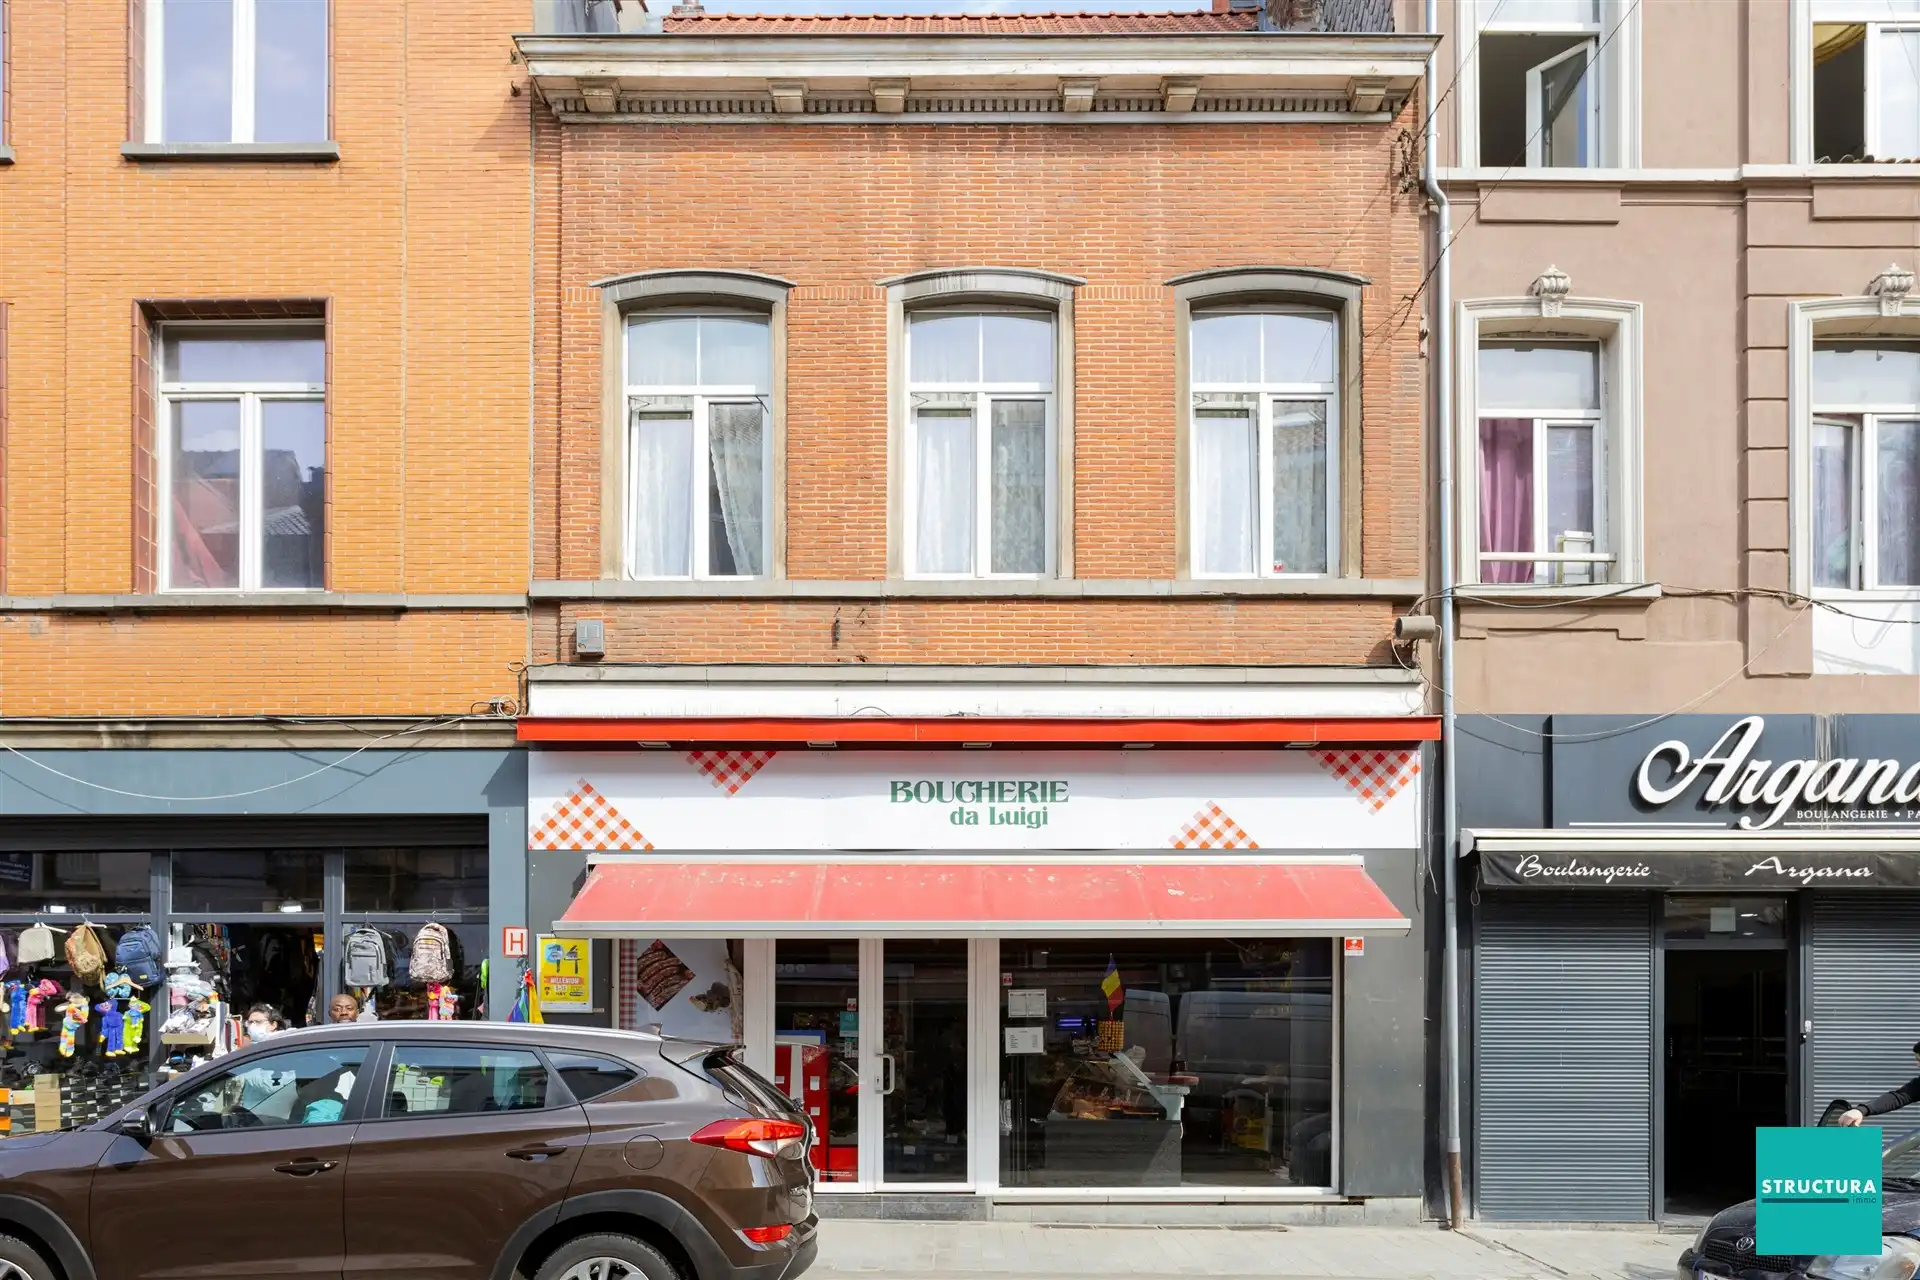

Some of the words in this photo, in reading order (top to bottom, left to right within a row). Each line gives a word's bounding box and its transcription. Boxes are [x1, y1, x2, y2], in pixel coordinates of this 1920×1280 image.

[890, 780, 1069, 804] BOUCHERIE
[950, 806, 979, 826] da
[989, 806, 1048, 829] Luigi
[1796, 810, 1888, 819] BOULANGERIE
[1515, 854, 1651, 884] Boulangerie
[1744, 856, 1874, 885] Argana
[510, 932, 524, 952] H
